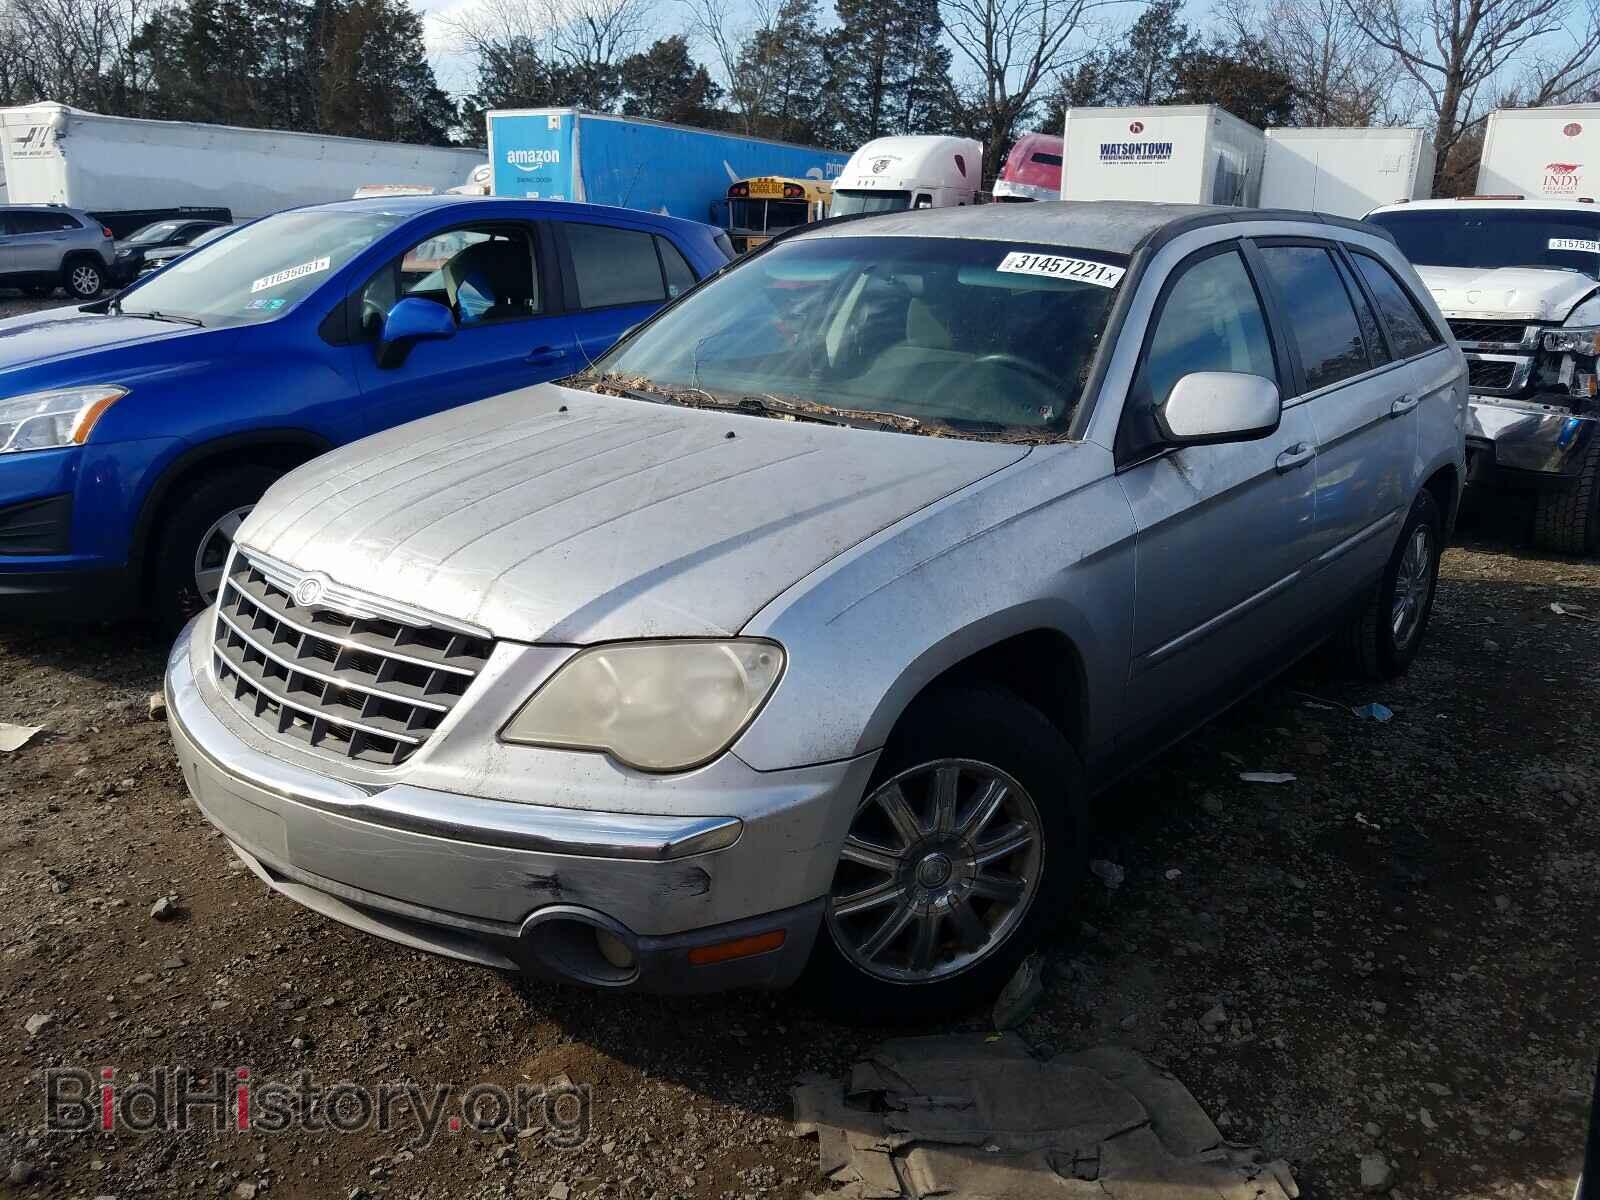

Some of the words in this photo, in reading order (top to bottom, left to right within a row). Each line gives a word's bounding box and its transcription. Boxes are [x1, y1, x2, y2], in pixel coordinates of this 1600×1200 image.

[1100, 142, 1173, 155] WATSONTOWN
[507, 149, 560, 164] amazon
[1543, 175, 1580, 186] INDY
[751, 183, 773, 194] SCHOOL
[773, 183, 784, 194] BUS
